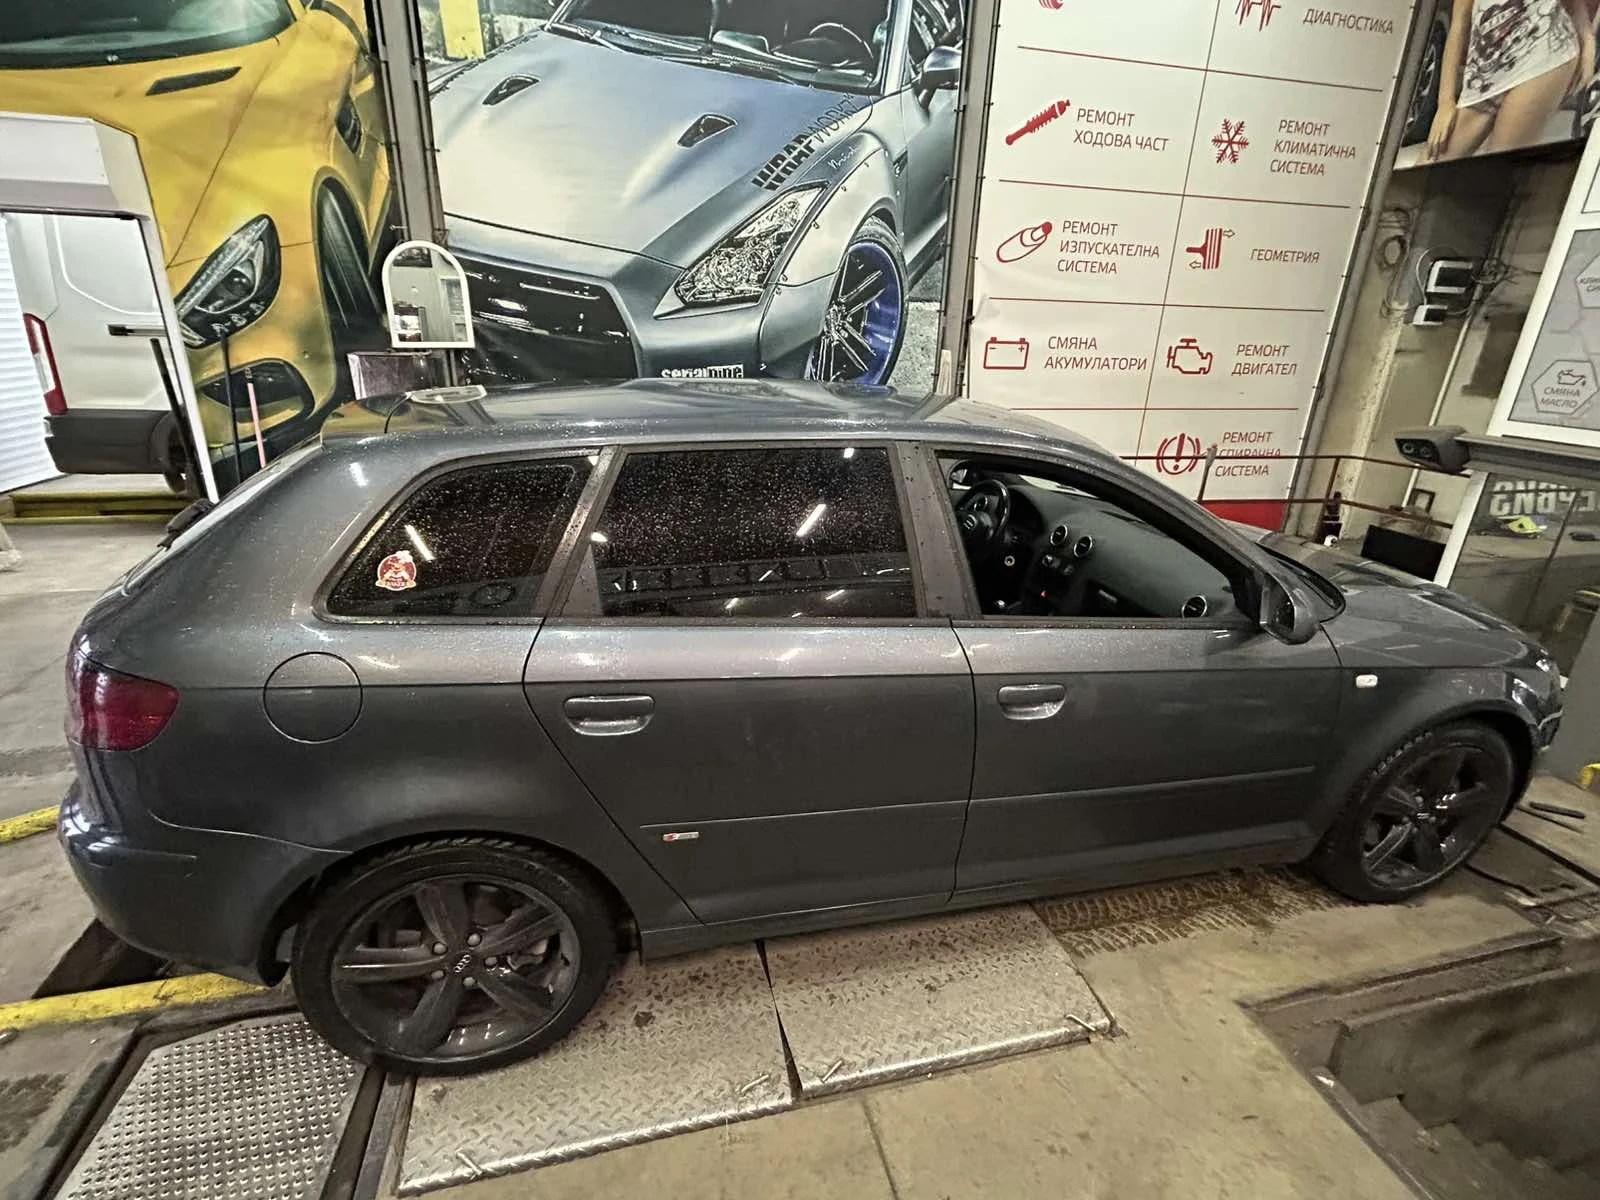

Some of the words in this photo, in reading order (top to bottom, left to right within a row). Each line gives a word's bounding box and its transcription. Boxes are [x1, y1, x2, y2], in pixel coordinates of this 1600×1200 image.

[1303, 8, 1394, 34] ДИАГНОСТИКА
[1076, 108, 1135, 127] РЕМОНТ
[1278, 119, 1330, 136] РЕМОНТ
[1073, 129, 1132, 149] ХОДОВА
[1134, 136, 1169, 152] ЧАСТ
[1273, 139, 1356, 159] КЛИМАТИЧНА
[1269, 159, 1326, 176] СИСТЕМА
[1062, 220, 1118, 237] РЕМОНТ
[1059, 240, 1160, 259] ИЗПУСКАТЕЛНА
[1250, 248, 1320, 264] ГЕОМЕТРИЯ
[1057, 259, 1118, 275] СИСТЕМА
[1047, 336, 1098, 351] СМЯНА
[1236, 344, 1290, 358] РЕМОНТ
[1044, 355, 1147, 372] АКУМУЛАТОРИ
[1231, 361, 1298, 377] ДВИГАТЕЛ
[1222, 431, 1274, 444] РЕМОНТ
[1215, 465, 1270, 477] СИСТЕМА
